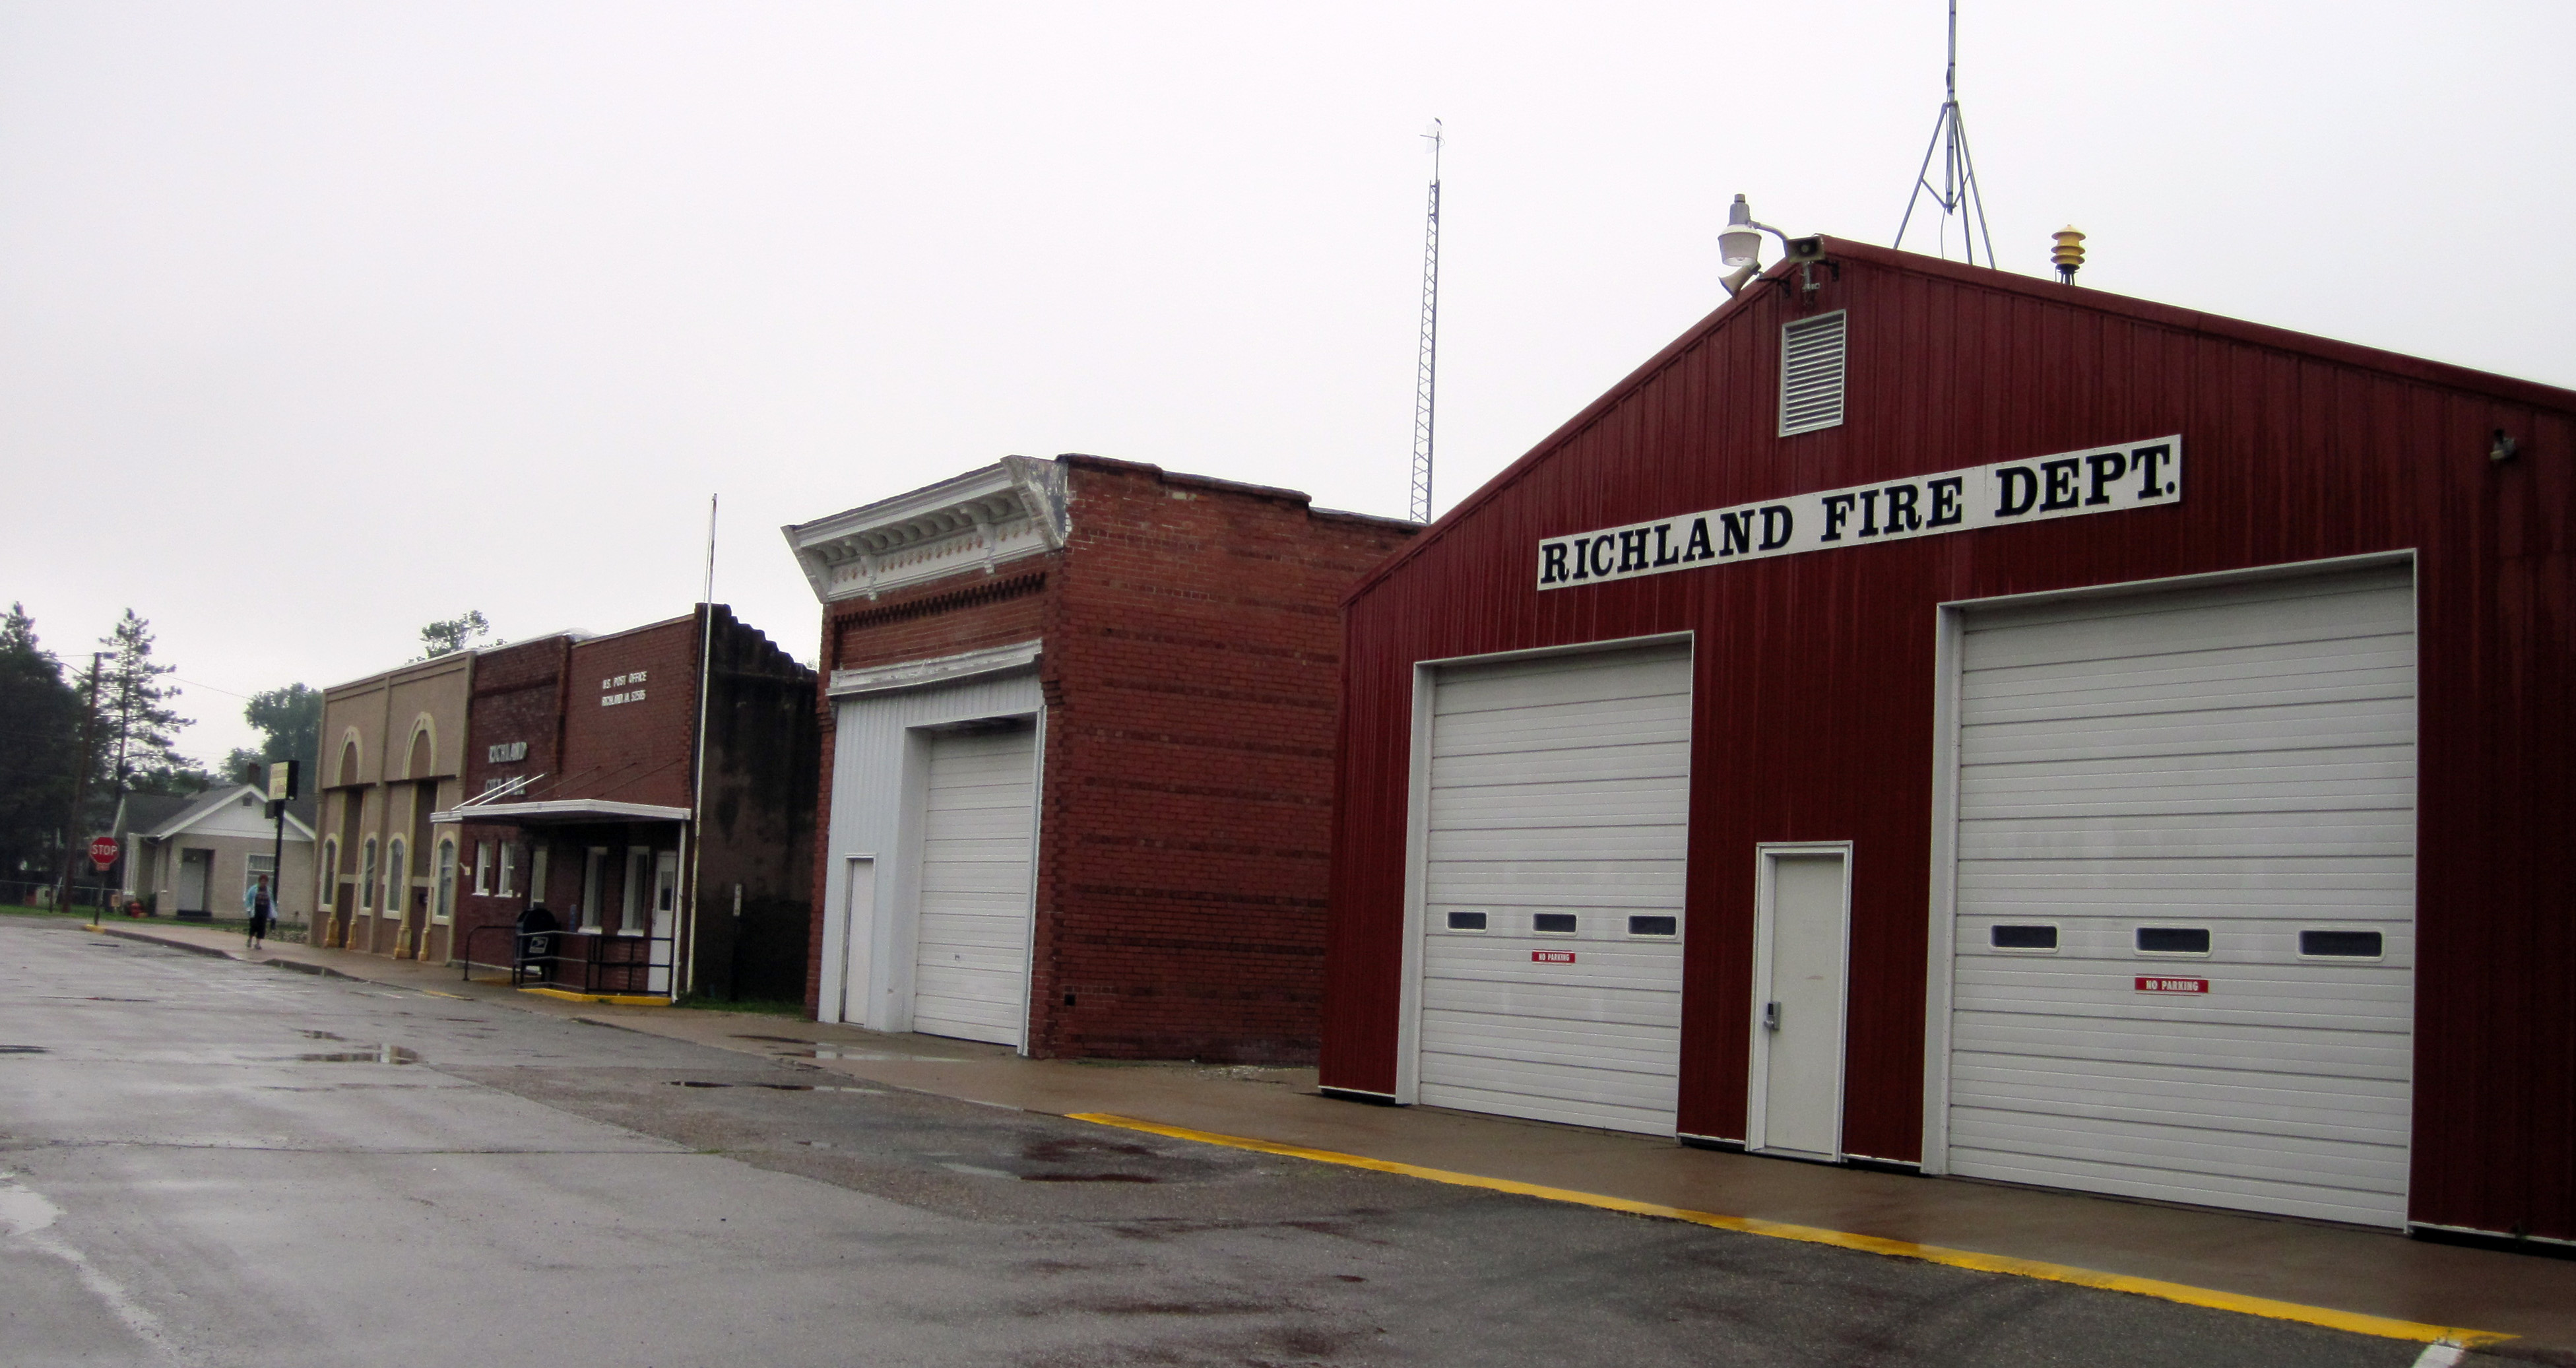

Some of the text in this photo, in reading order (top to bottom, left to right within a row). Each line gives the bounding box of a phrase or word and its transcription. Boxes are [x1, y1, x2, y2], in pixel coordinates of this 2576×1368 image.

[1540, 443, 2175, 584] RICHLAND FIRE DEPT.
[614, 675, 627, 687] POST
[629, 670, 647, 684] OFFICE
[488, 741, 527, 763] RICHLAND
[92, 845, 117, 855] STOP
[1547, 953, 1570, 961] PARKING
[2146, 980, 2199, 991] NO PARKING
